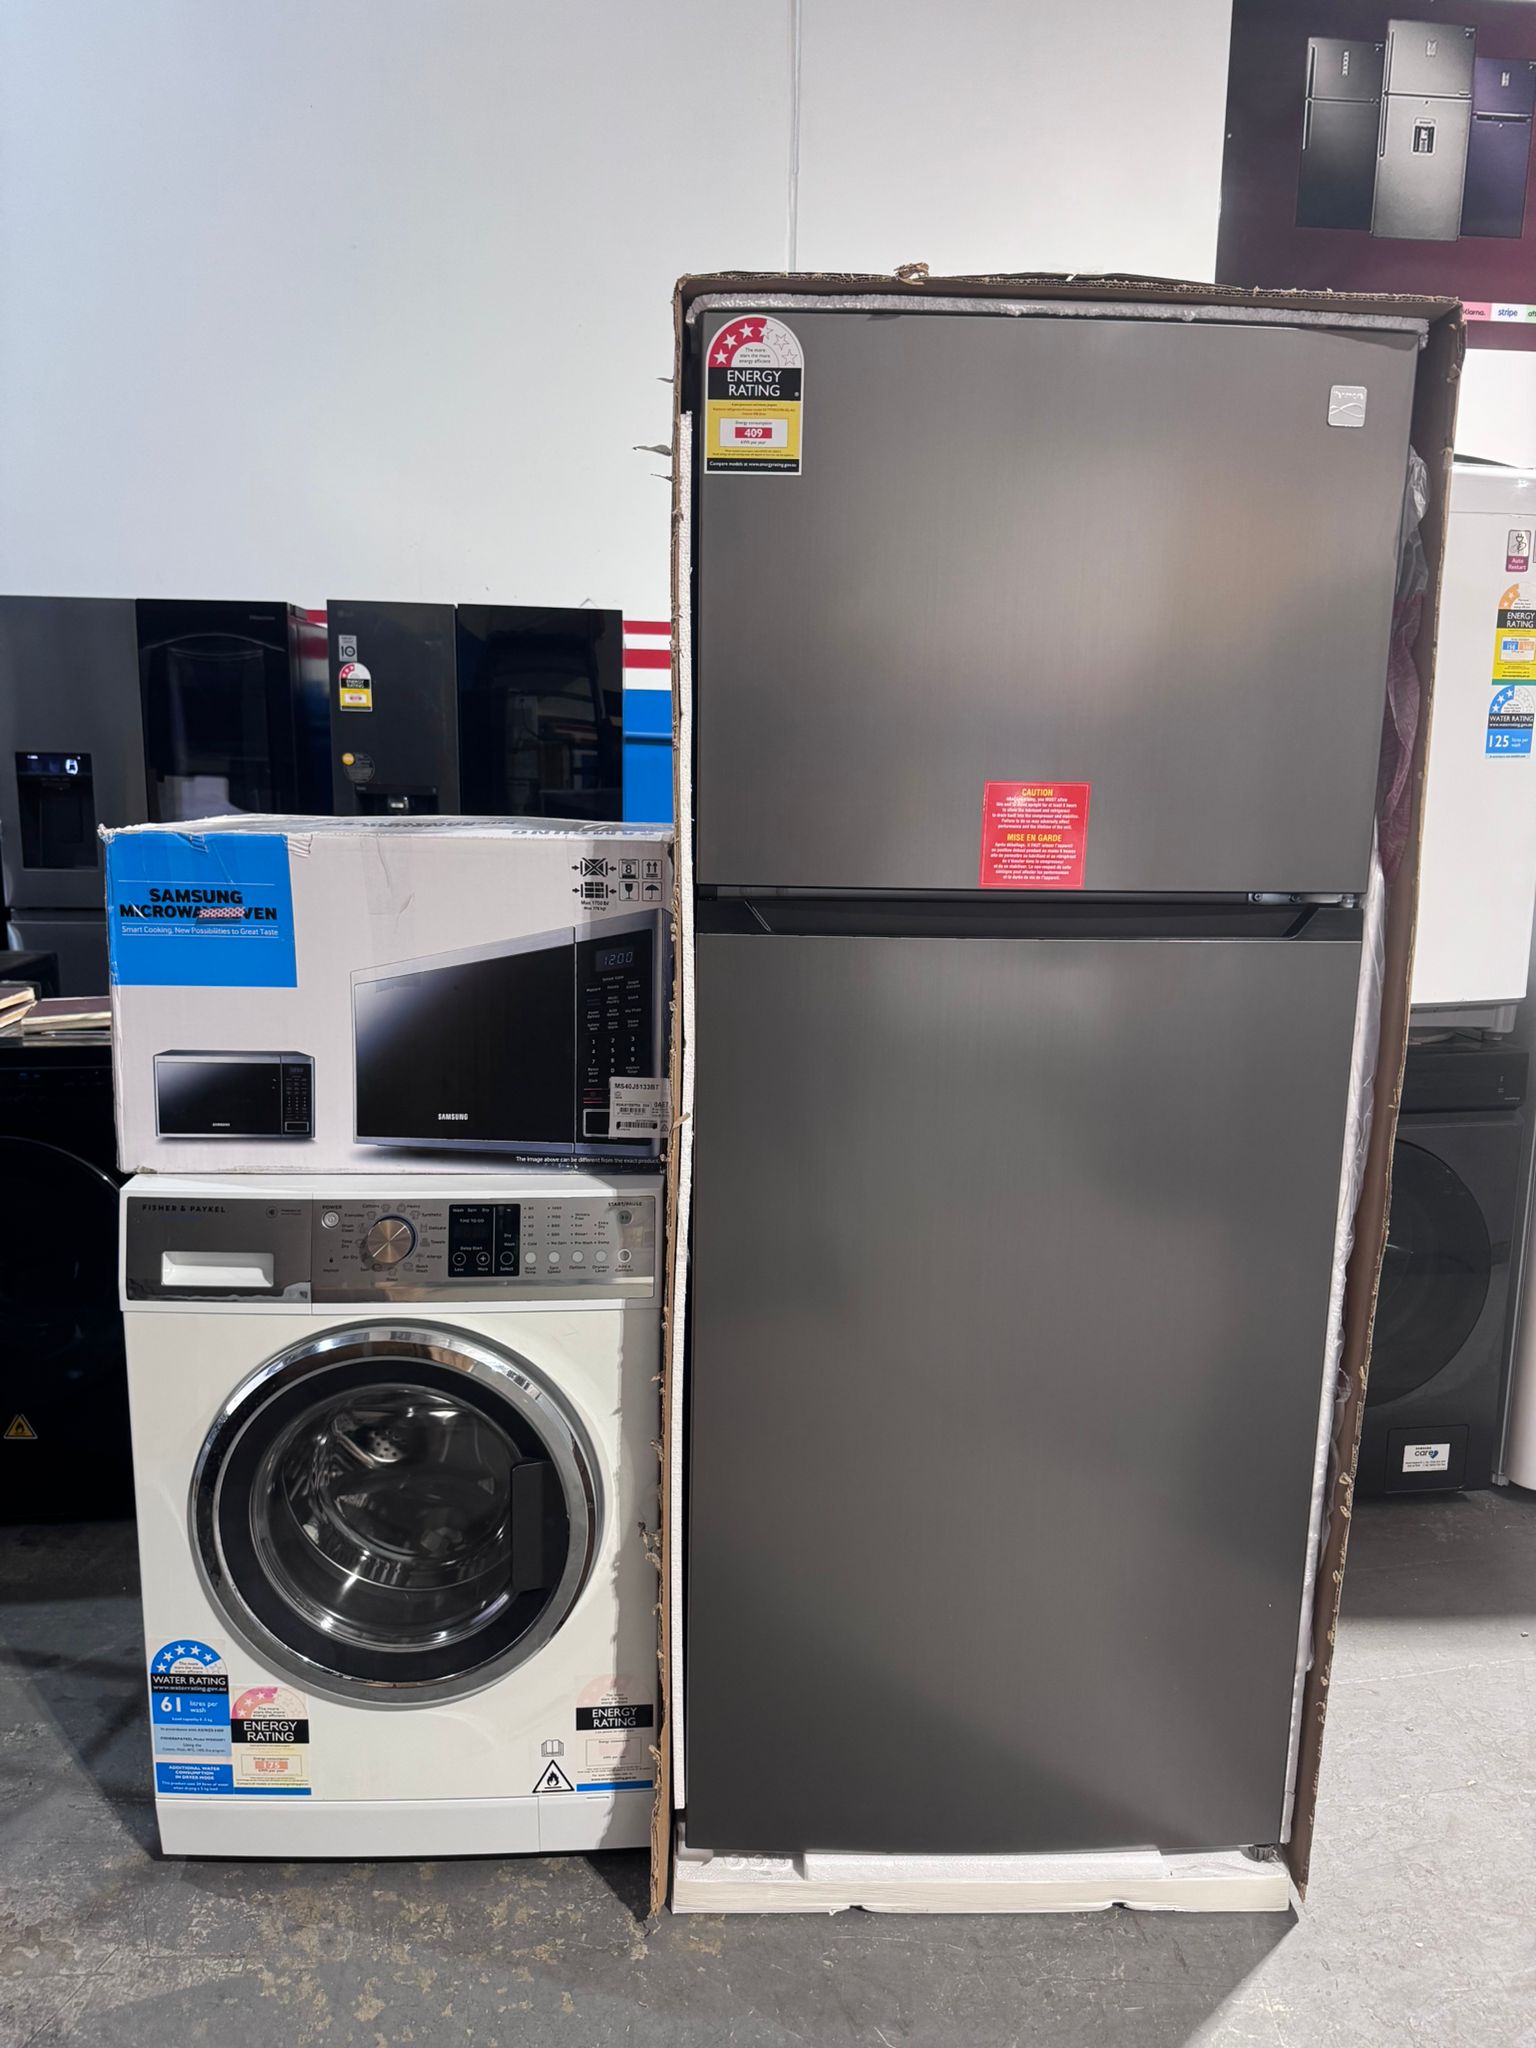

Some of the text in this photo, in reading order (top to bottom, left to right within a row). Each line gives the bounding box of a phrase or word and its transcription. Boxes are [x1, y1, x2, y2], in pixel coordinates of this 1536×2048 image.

[1498, 308, 1518, 318] stripe
[727, 370, 782, 382] ENERGY
[728, 384, 780, 396] RATING
[744, 428, 762, 437] 409
[1506, 612, 1535, 620] ENERGY
[1506, 620, 1534, 628] RATING
[1489, 735, 1509, 748] 125
[1022, 788, 1053, 796] CAUTION
[1038, 834, 1062, 842] GARDE
[625, 864, 632, 873] 8
[149, 888, 243, 904] SAMSUNG
[144, 926, 173, 935] Cooking,
[260, 928, 279, 936] Taste
[153, 1676, 226, 1685] WATER RATING
[161, 1696, 181, 1712] 61
[592, 1707, 637, 1718] ENERGY
[243, 1721, 297, 1731] ENERGY
[593, 1718, 636, 1728] RATING
[247, 1732, 295, 1742] RATING
